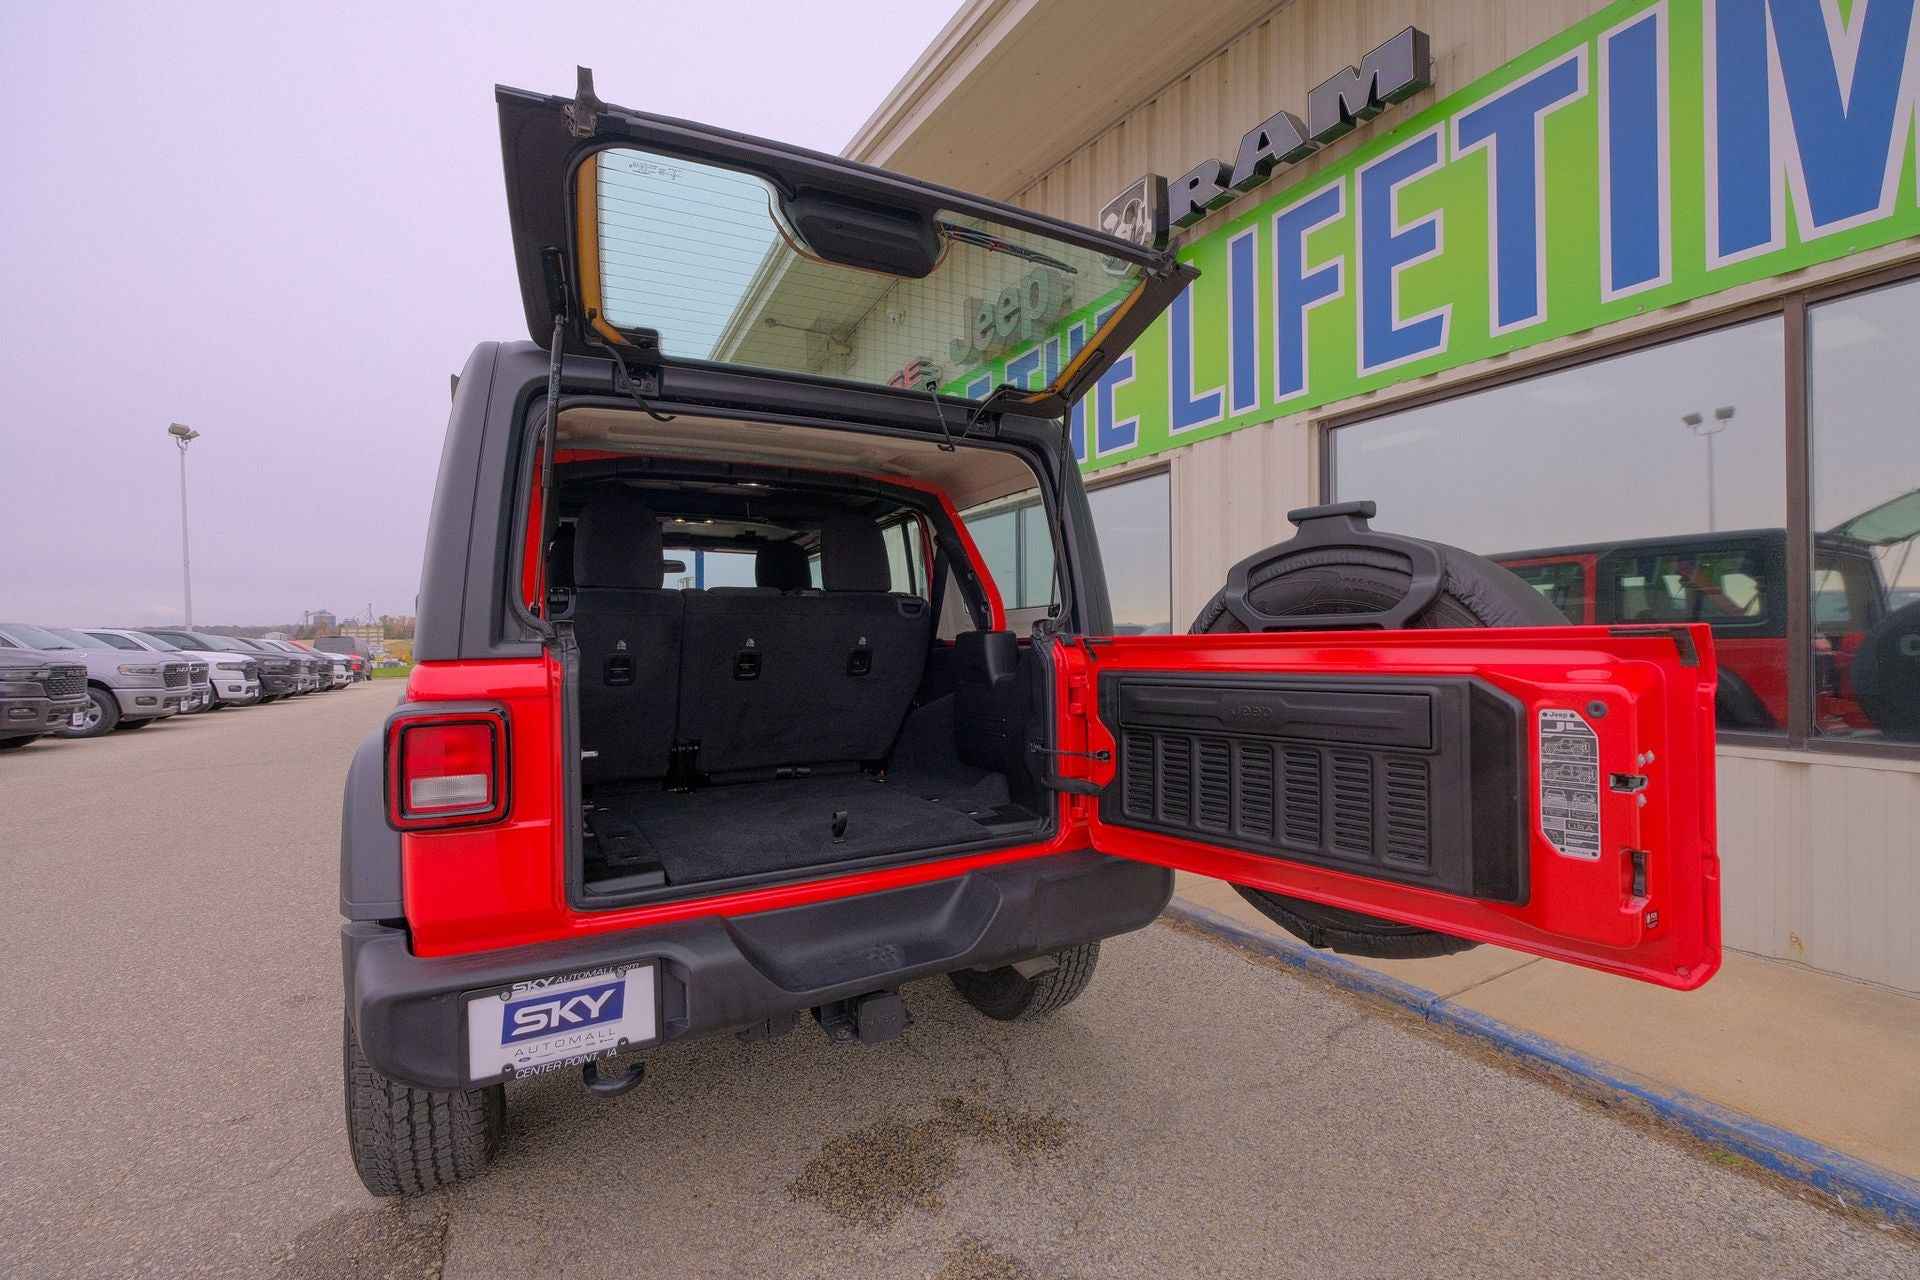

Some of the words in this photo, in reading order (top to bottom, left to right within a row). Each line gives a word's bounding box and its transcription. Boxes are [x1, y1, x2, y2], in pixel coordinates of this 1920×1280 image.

[1168, 26, 1429, 227] RAM
[1168, 0, 1920, 434] LIFETIM
[949, 266, 1052, 364] Jeep
[1549, 711, 1568, 719] Jeep
[512, 976, 555, 992] SKY
[511, 989, 616, 1036] SKY
[514, 1028, 616, 1057] AUTOMALL
[515, 1061, 562, 1079] CENTER
[606, 1047, 617, 1058] IA
